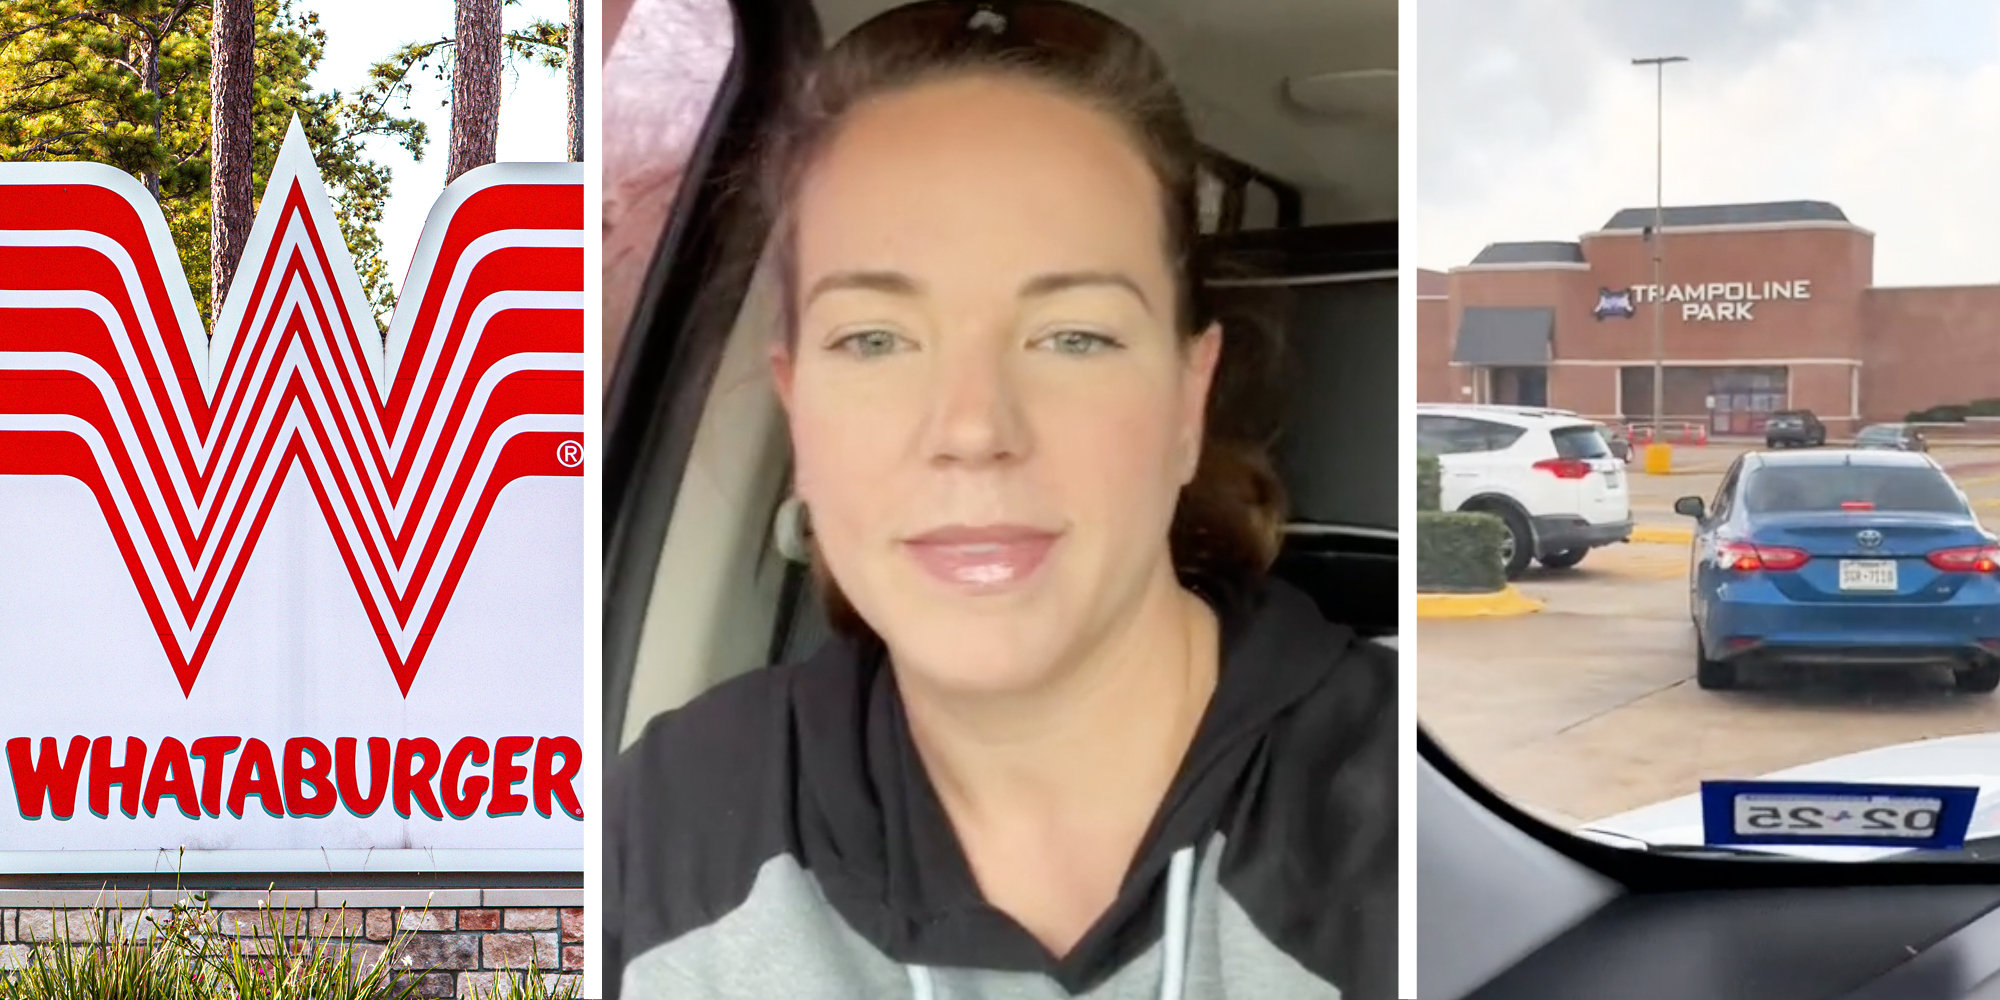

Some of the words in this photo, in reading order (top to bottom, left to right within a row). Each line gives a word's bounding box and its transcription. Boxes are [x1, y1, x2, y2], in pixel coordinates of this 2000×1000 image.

[1631, 280, 1811, 303] TRAMPOLINE
[1682, 302, 1753, 321] PARK
[6, 735, 584, 821] WHATABURGER
